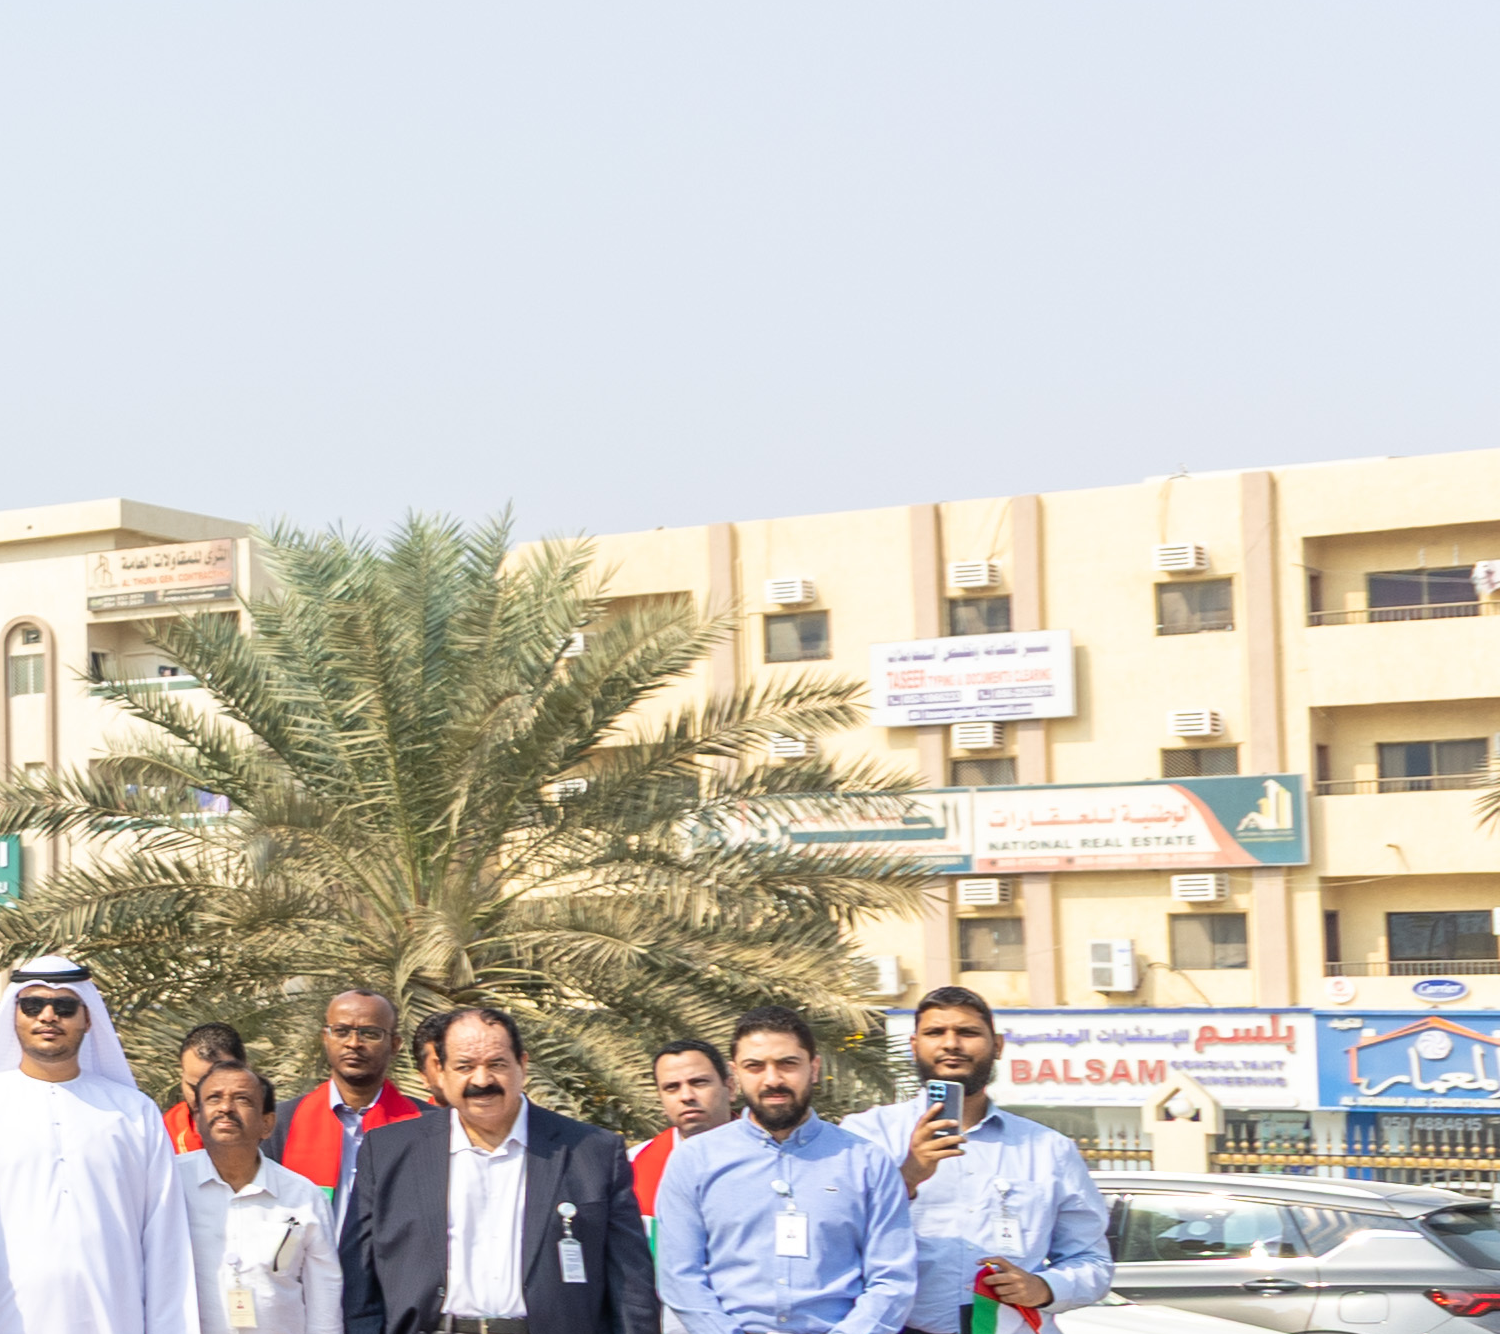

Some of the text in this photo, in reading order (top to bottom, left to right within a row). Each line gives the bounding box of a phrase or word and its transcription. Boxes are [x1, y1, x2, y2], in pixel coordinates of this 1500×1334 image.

[989, 805, 1116, 831] للعقارات
[1122, 802, 1191, 829] الوطنية
[988, 834, 1196, 851] NATIONAL REAL ESTATE
[1417, 982, 1463, 994] Carrier
[1195, 1014, 1296, 1053] بلسم
[1011, 1059, 1166, 1084] BALSAM
[1382, 1117, 1410, 1129] 050
